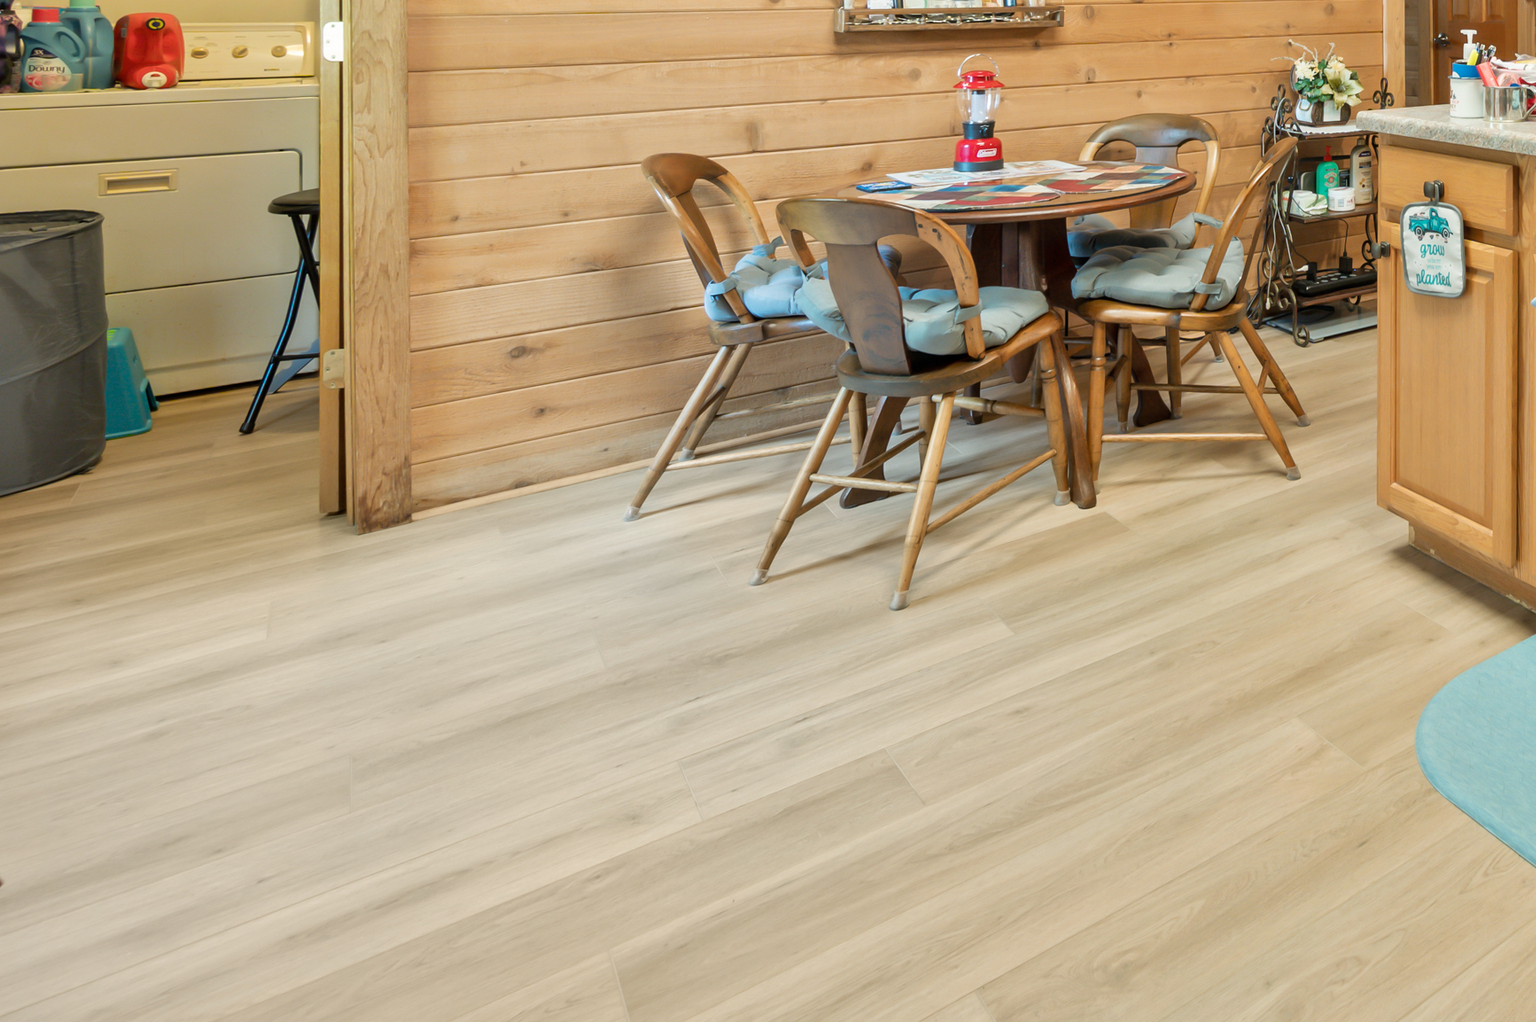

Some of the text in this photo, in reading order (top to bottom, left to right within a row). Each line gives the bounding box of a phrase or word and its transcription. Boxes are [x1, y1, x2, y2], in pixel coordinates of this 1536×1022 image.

[28, 64, 66, 74] Downy
[1420, 243, 1446, 259] grow
[1415, 269, 1452, 288] planted
